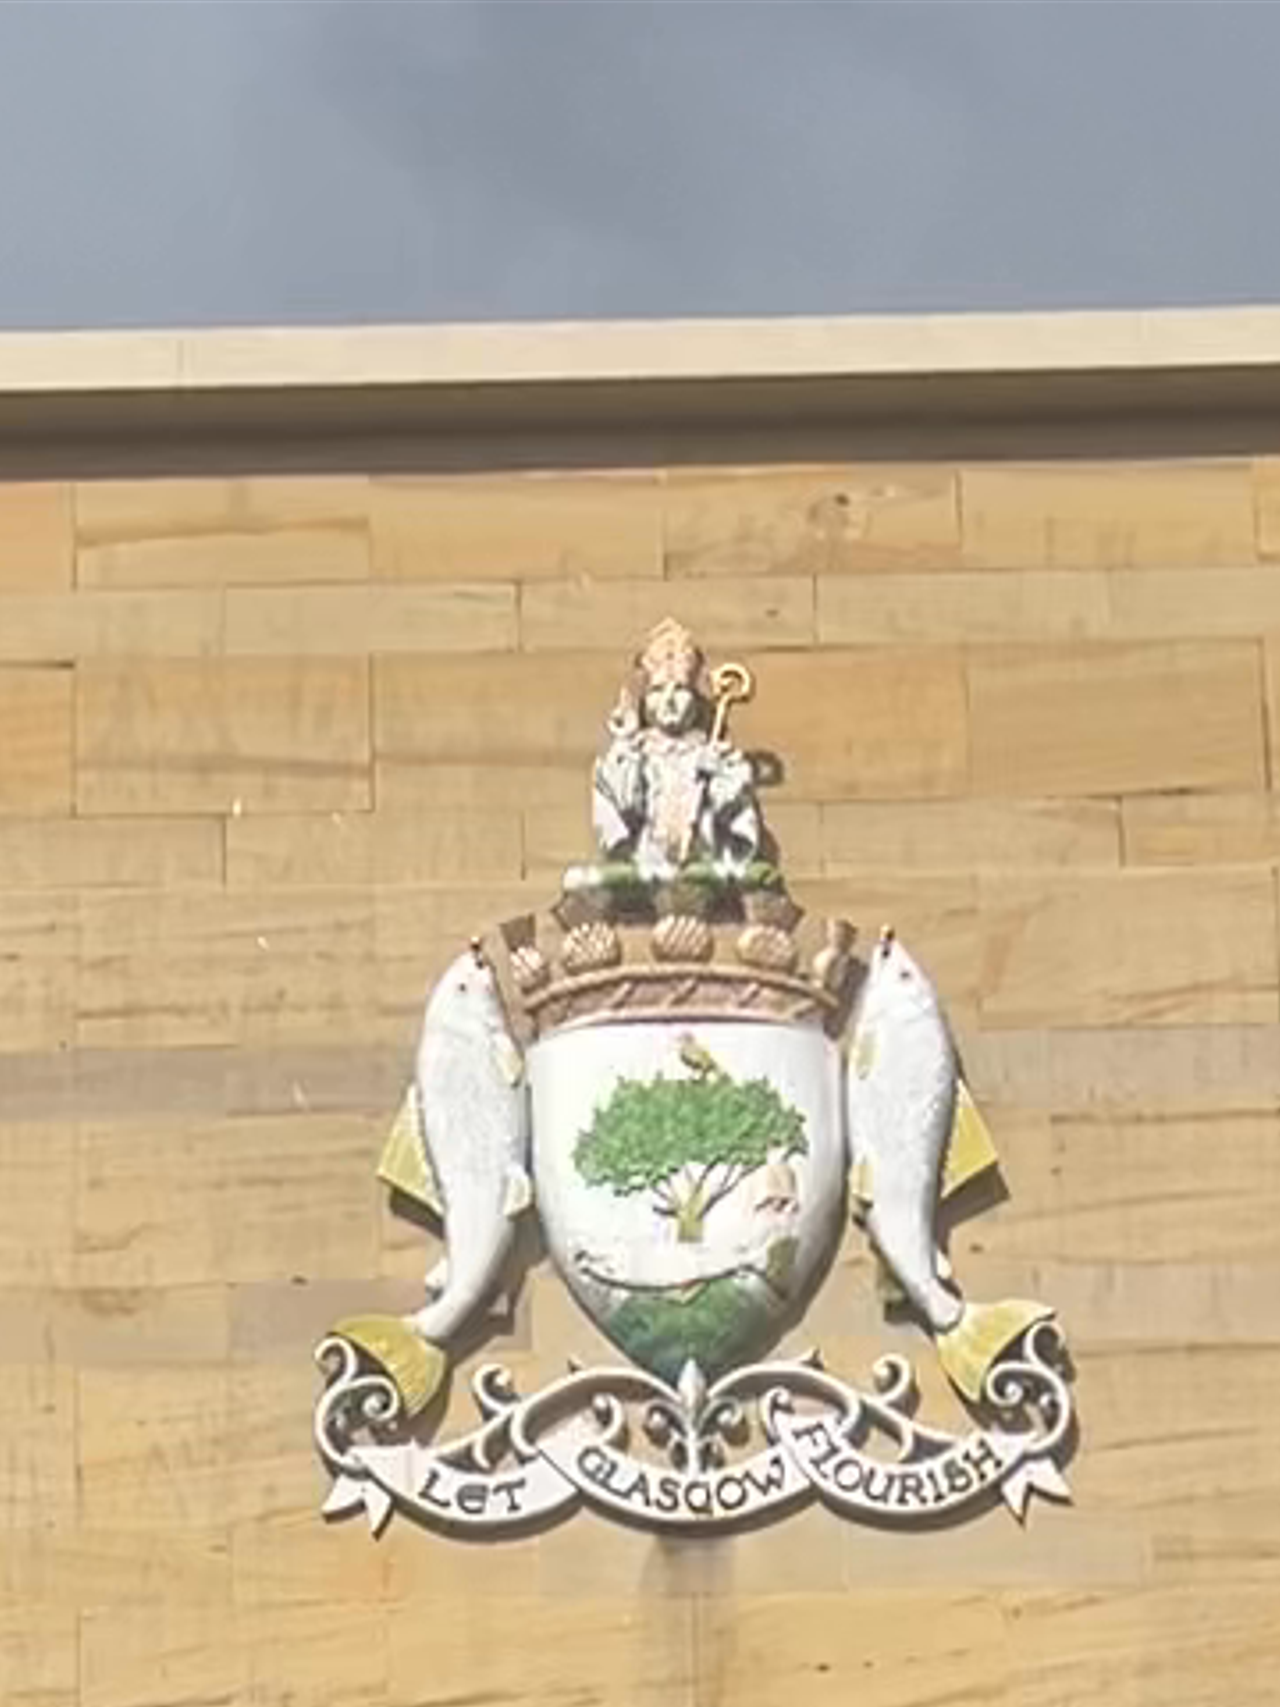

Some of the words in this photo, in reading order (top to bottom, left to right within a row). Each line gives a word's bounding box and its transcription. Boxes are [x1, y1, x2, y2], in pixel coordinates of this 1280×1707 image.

[418, 1468, 527, 1514] LET
[576, 1446, 787, 1514] GLASGOW
[791, 1421, 1003, 1505] FLOURISH
